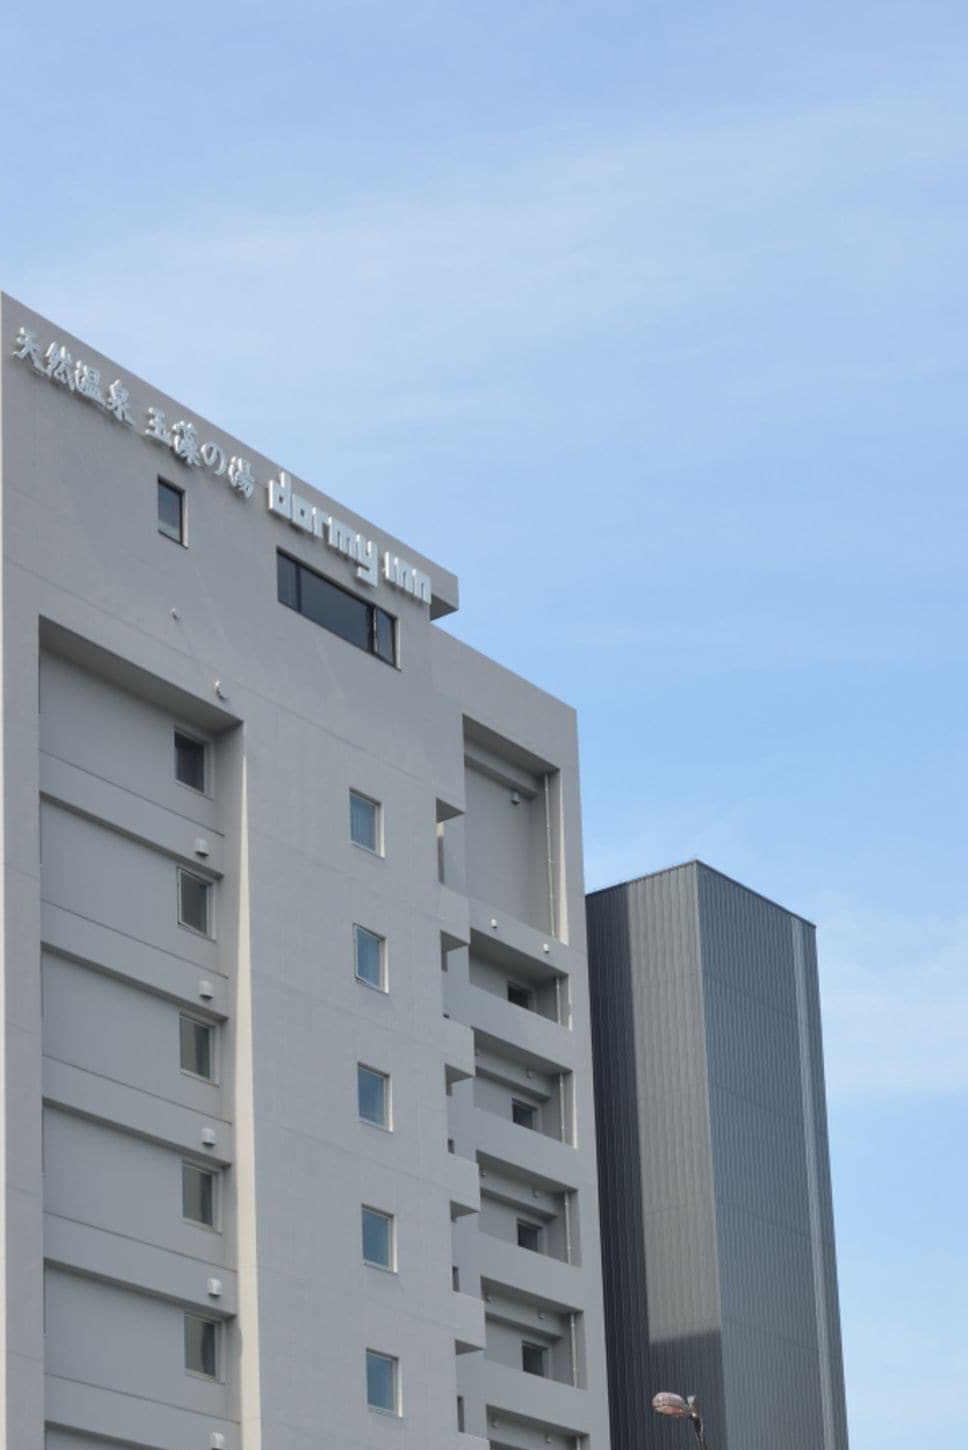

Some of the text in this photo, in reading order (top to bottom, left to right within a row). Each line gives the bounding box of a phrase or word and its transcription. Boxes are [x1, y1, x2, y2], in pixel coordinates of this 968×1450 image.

[12, 326, 432, 605] 天然温泉 玉藻の湯 dormy inn
